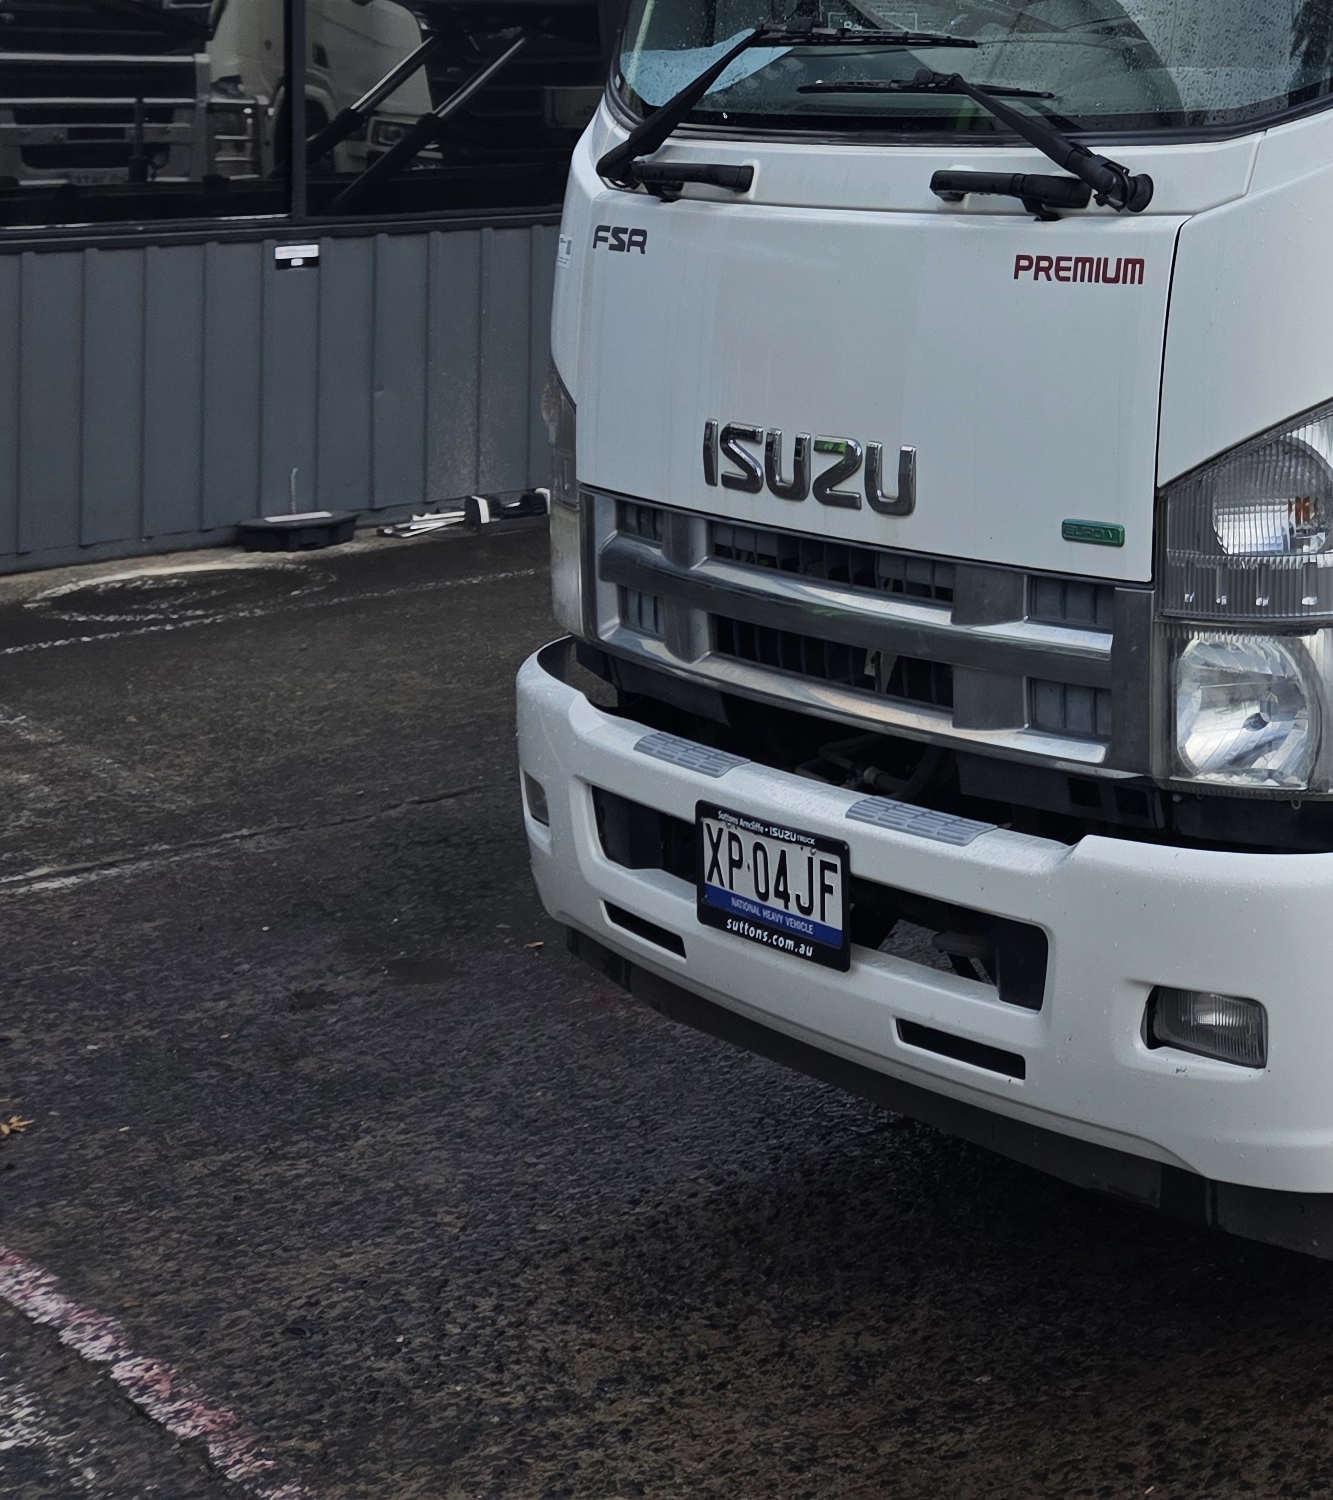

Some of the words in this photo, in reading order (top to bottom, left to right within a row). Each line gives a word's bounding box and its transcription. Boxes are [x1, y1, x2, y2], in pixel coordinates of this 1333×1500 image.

[592, 224, 648, 255] FSR
[1013, 254, 1145, 285] PREMIUM
[702, 418, 917, 517] ISUZU
[717, 810, 739, 825] Suttons
[769, 826, 797, 842] ISUZU
[731, 896, 761, 917] NATIONAL
[762, 908, 785, 925] HEAVY
[784, 916, 814, 935] VEHICLE
[726, 918, 814, 958] suttons.com.au
